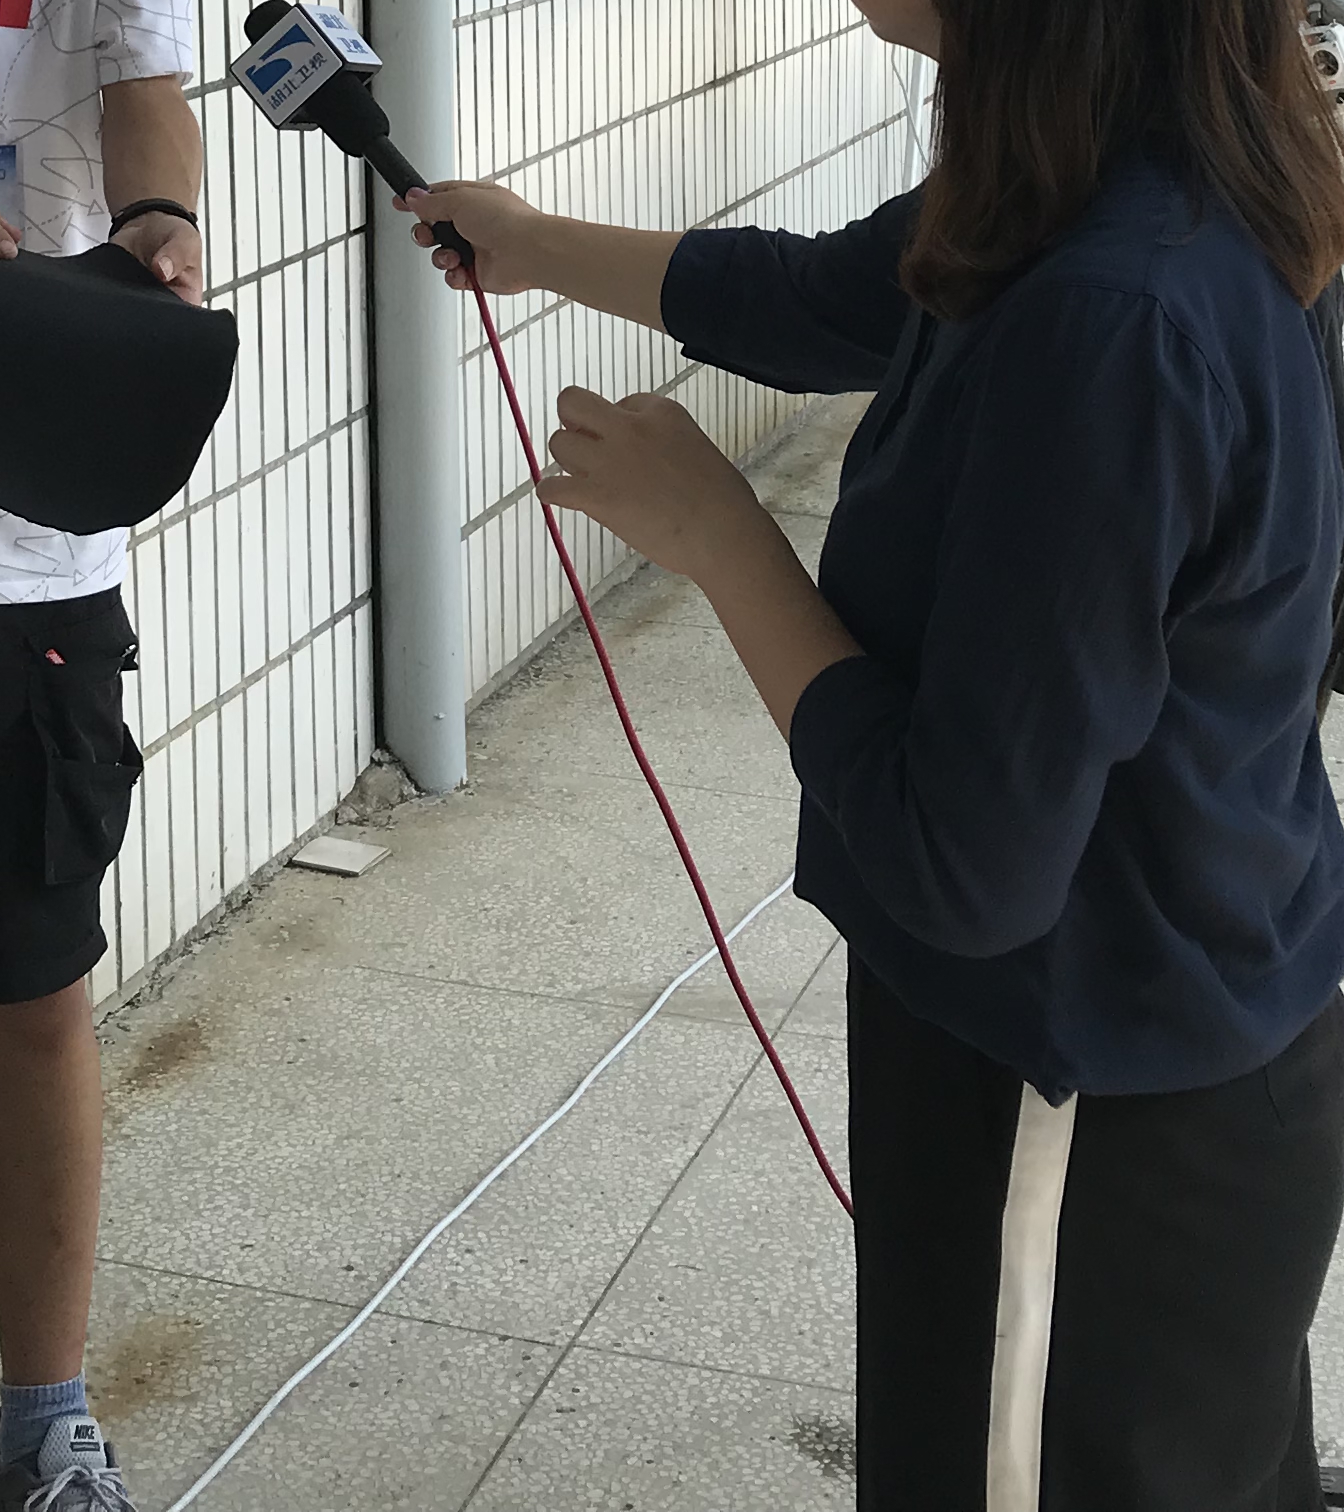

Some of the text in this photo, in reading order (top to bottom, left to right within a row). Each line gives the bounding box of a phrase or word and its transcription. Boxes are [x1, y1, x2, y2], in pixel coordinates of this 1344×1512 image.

[266, 51, 328, 110] 湖北卫视
[73, 1424, 96, 1440] NIKE
